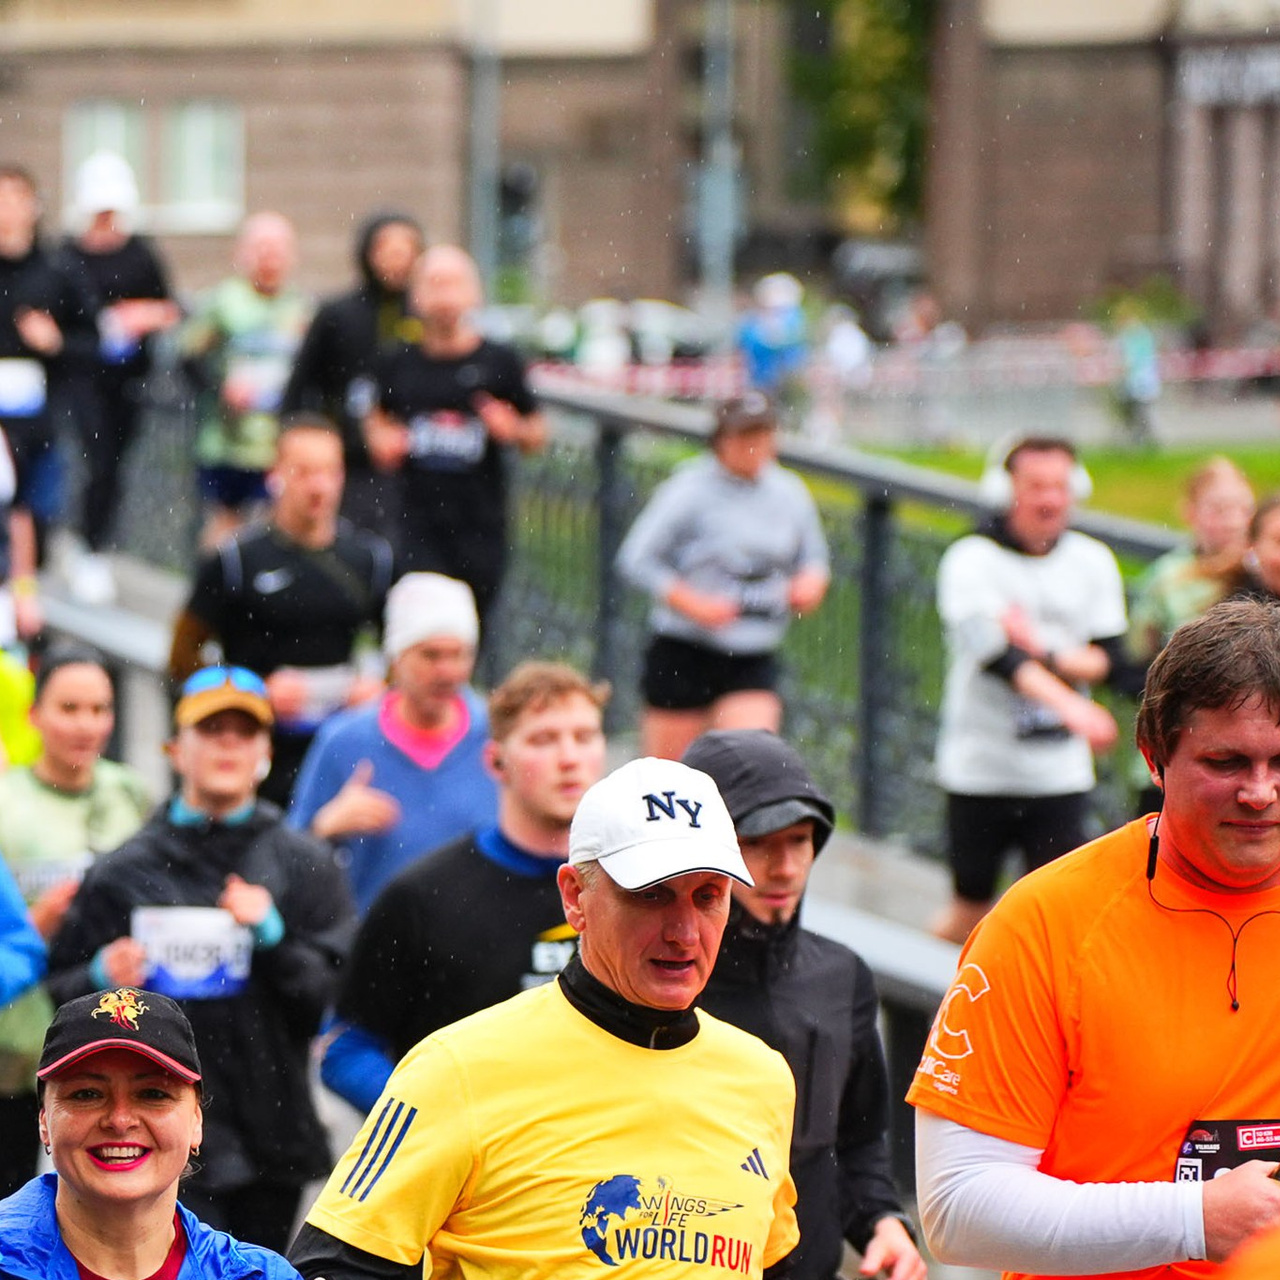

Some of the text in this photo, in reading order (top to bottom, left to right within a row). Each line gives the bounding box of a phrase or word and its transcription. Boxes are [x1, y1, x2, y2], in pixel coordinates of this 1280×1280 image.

[641, 791, 703, 828] NY
[642, 1194, 707, 1214] WINGS
[639, 1211, 654, 1219] FOR
[652, 1211, 690, 1228] LIFE
